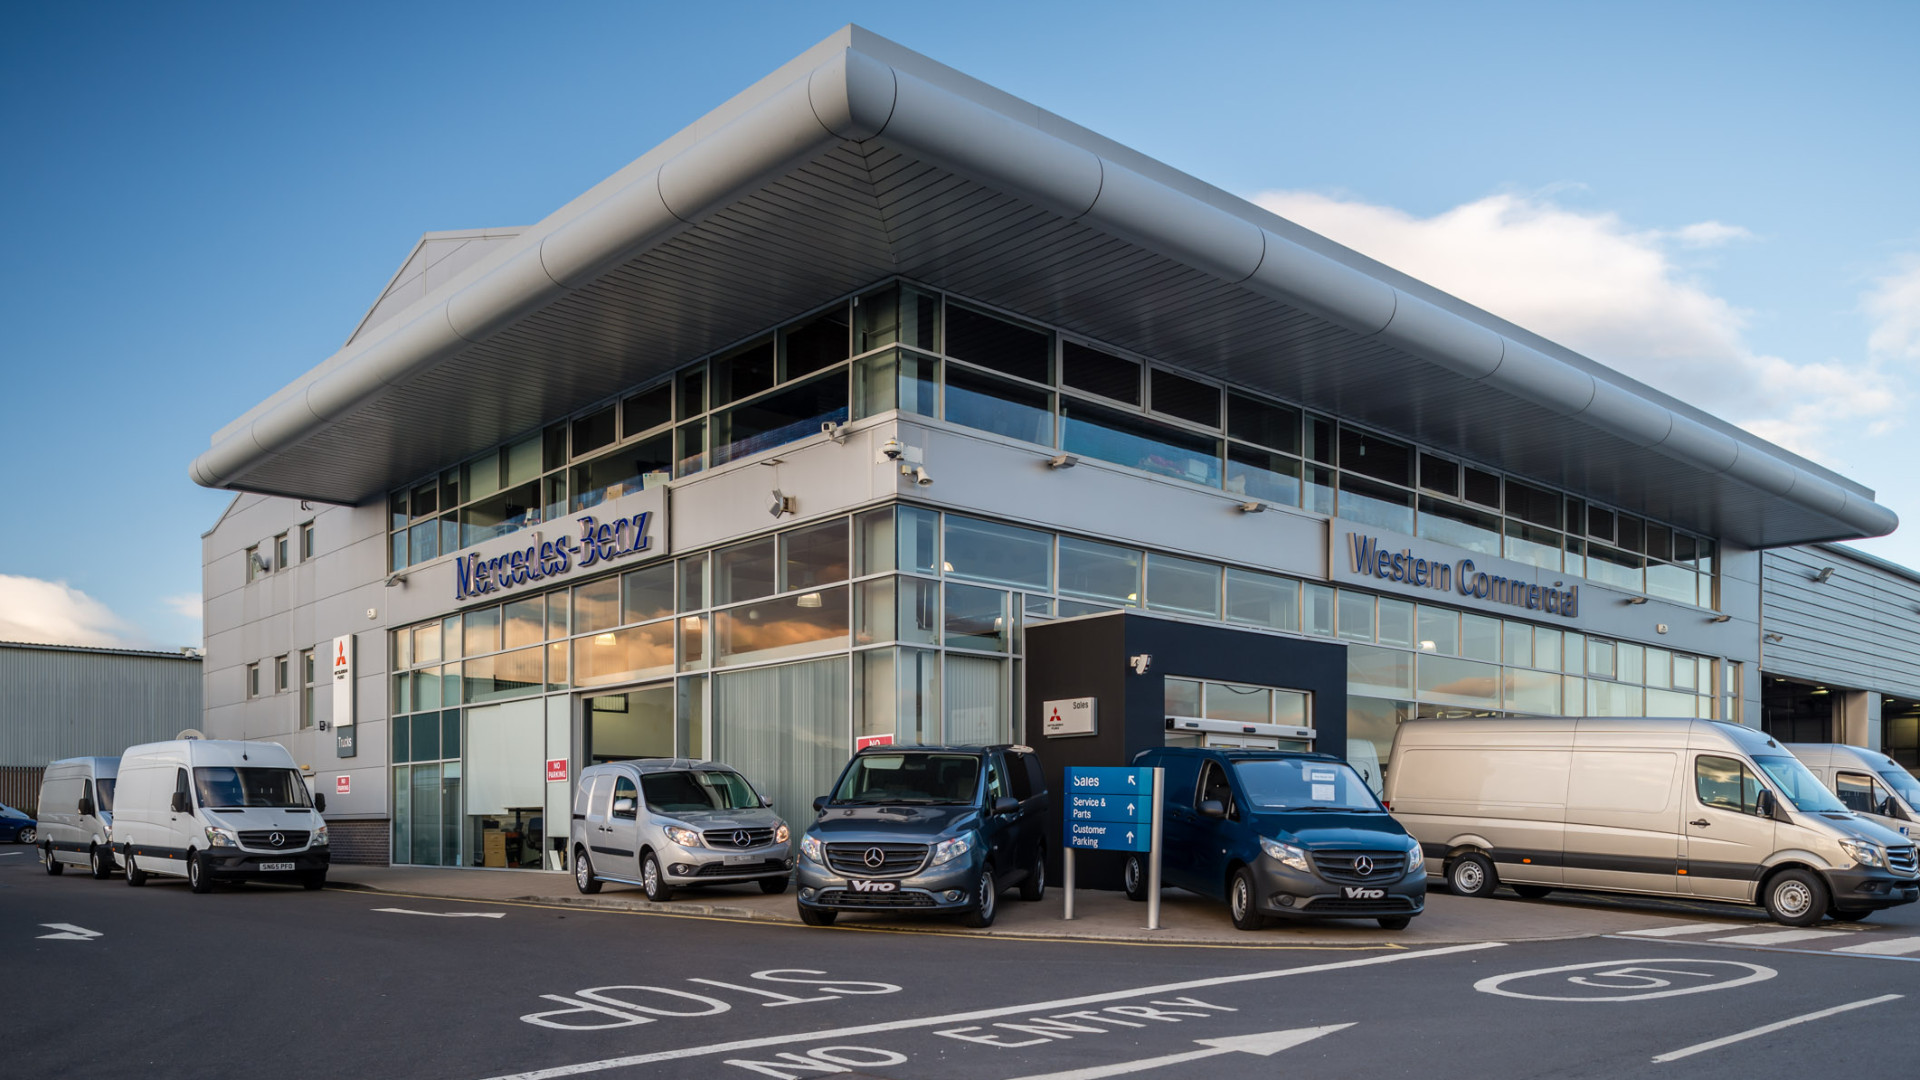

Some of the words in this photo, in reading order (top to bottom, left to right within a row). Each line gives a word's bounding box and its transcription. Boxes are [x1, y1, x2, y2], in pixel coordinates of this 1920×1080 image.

[456, 511, 652, 600] Mercedes-Benz
[1348, 532, 1451, 592] Western
[1457, 559, 1579, 618] Commercial
[1072, 701, 1089, 710] Sales
[1073, 775, 1100, 787] Sales
[1073, 796, 1099, 807] Service
[1100, 797, 1106, 807] &
[1072, 808, 1092, 819] Parts
[1072, 823, 1107, 835] Customer
[1072, 836, 1099, 849] Parking
[519, 969, 903, 1030] STOP
[723, 1045, 908, 1080] NO
[932, 996, 1239, 1048] ENTRY
